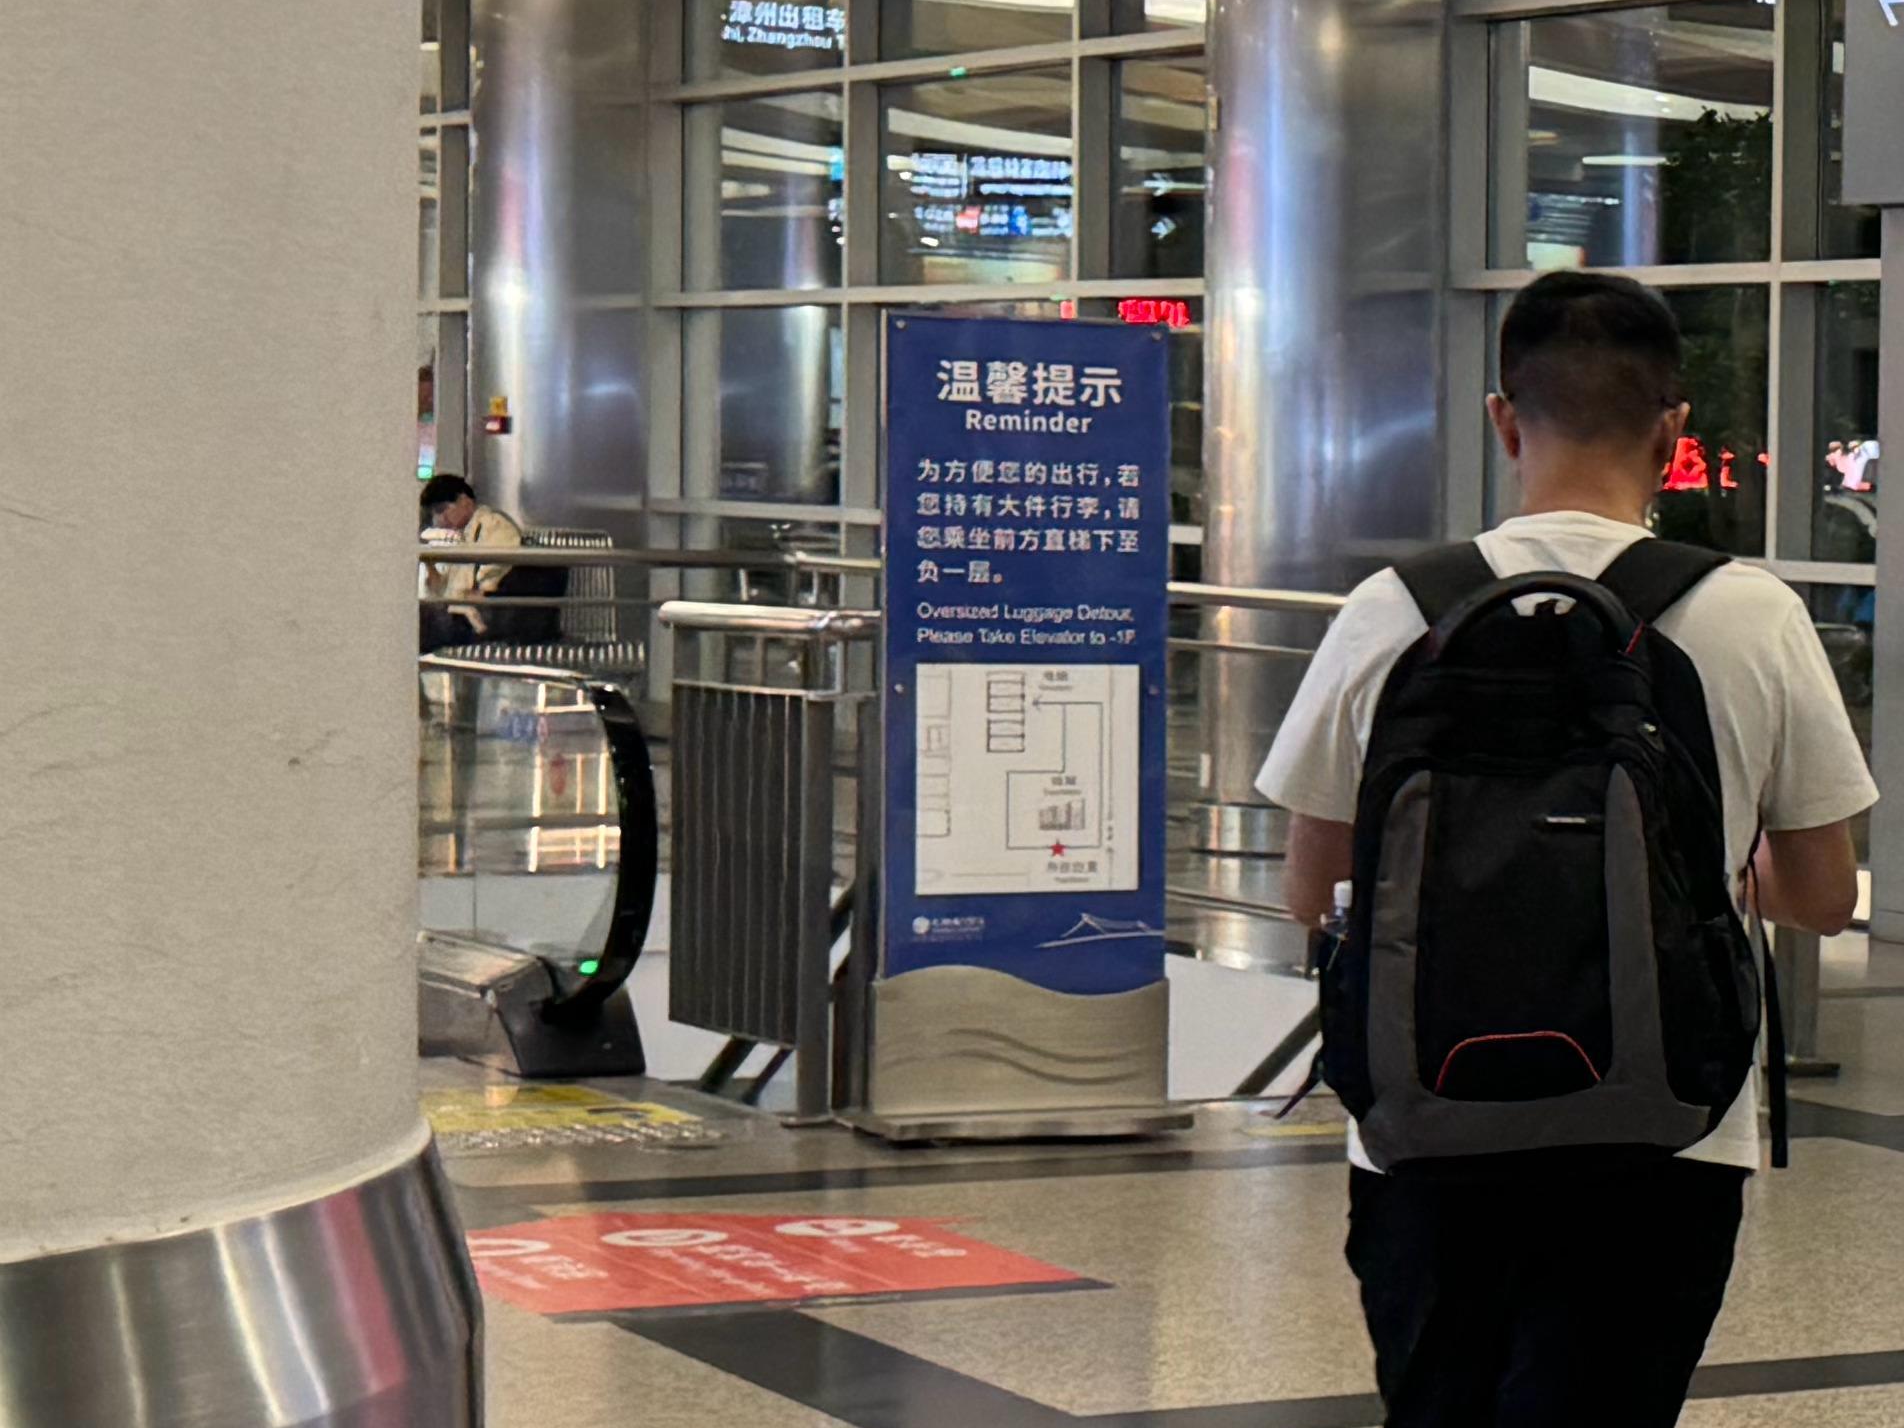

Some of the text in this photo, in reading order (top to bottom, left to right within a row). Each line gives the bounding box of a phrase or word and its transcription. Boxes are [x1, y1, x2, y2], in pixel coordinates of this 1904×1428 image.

[936, 360, 1122, 407] 温馨提示
[965, 410, 1092, 434] Reminder
